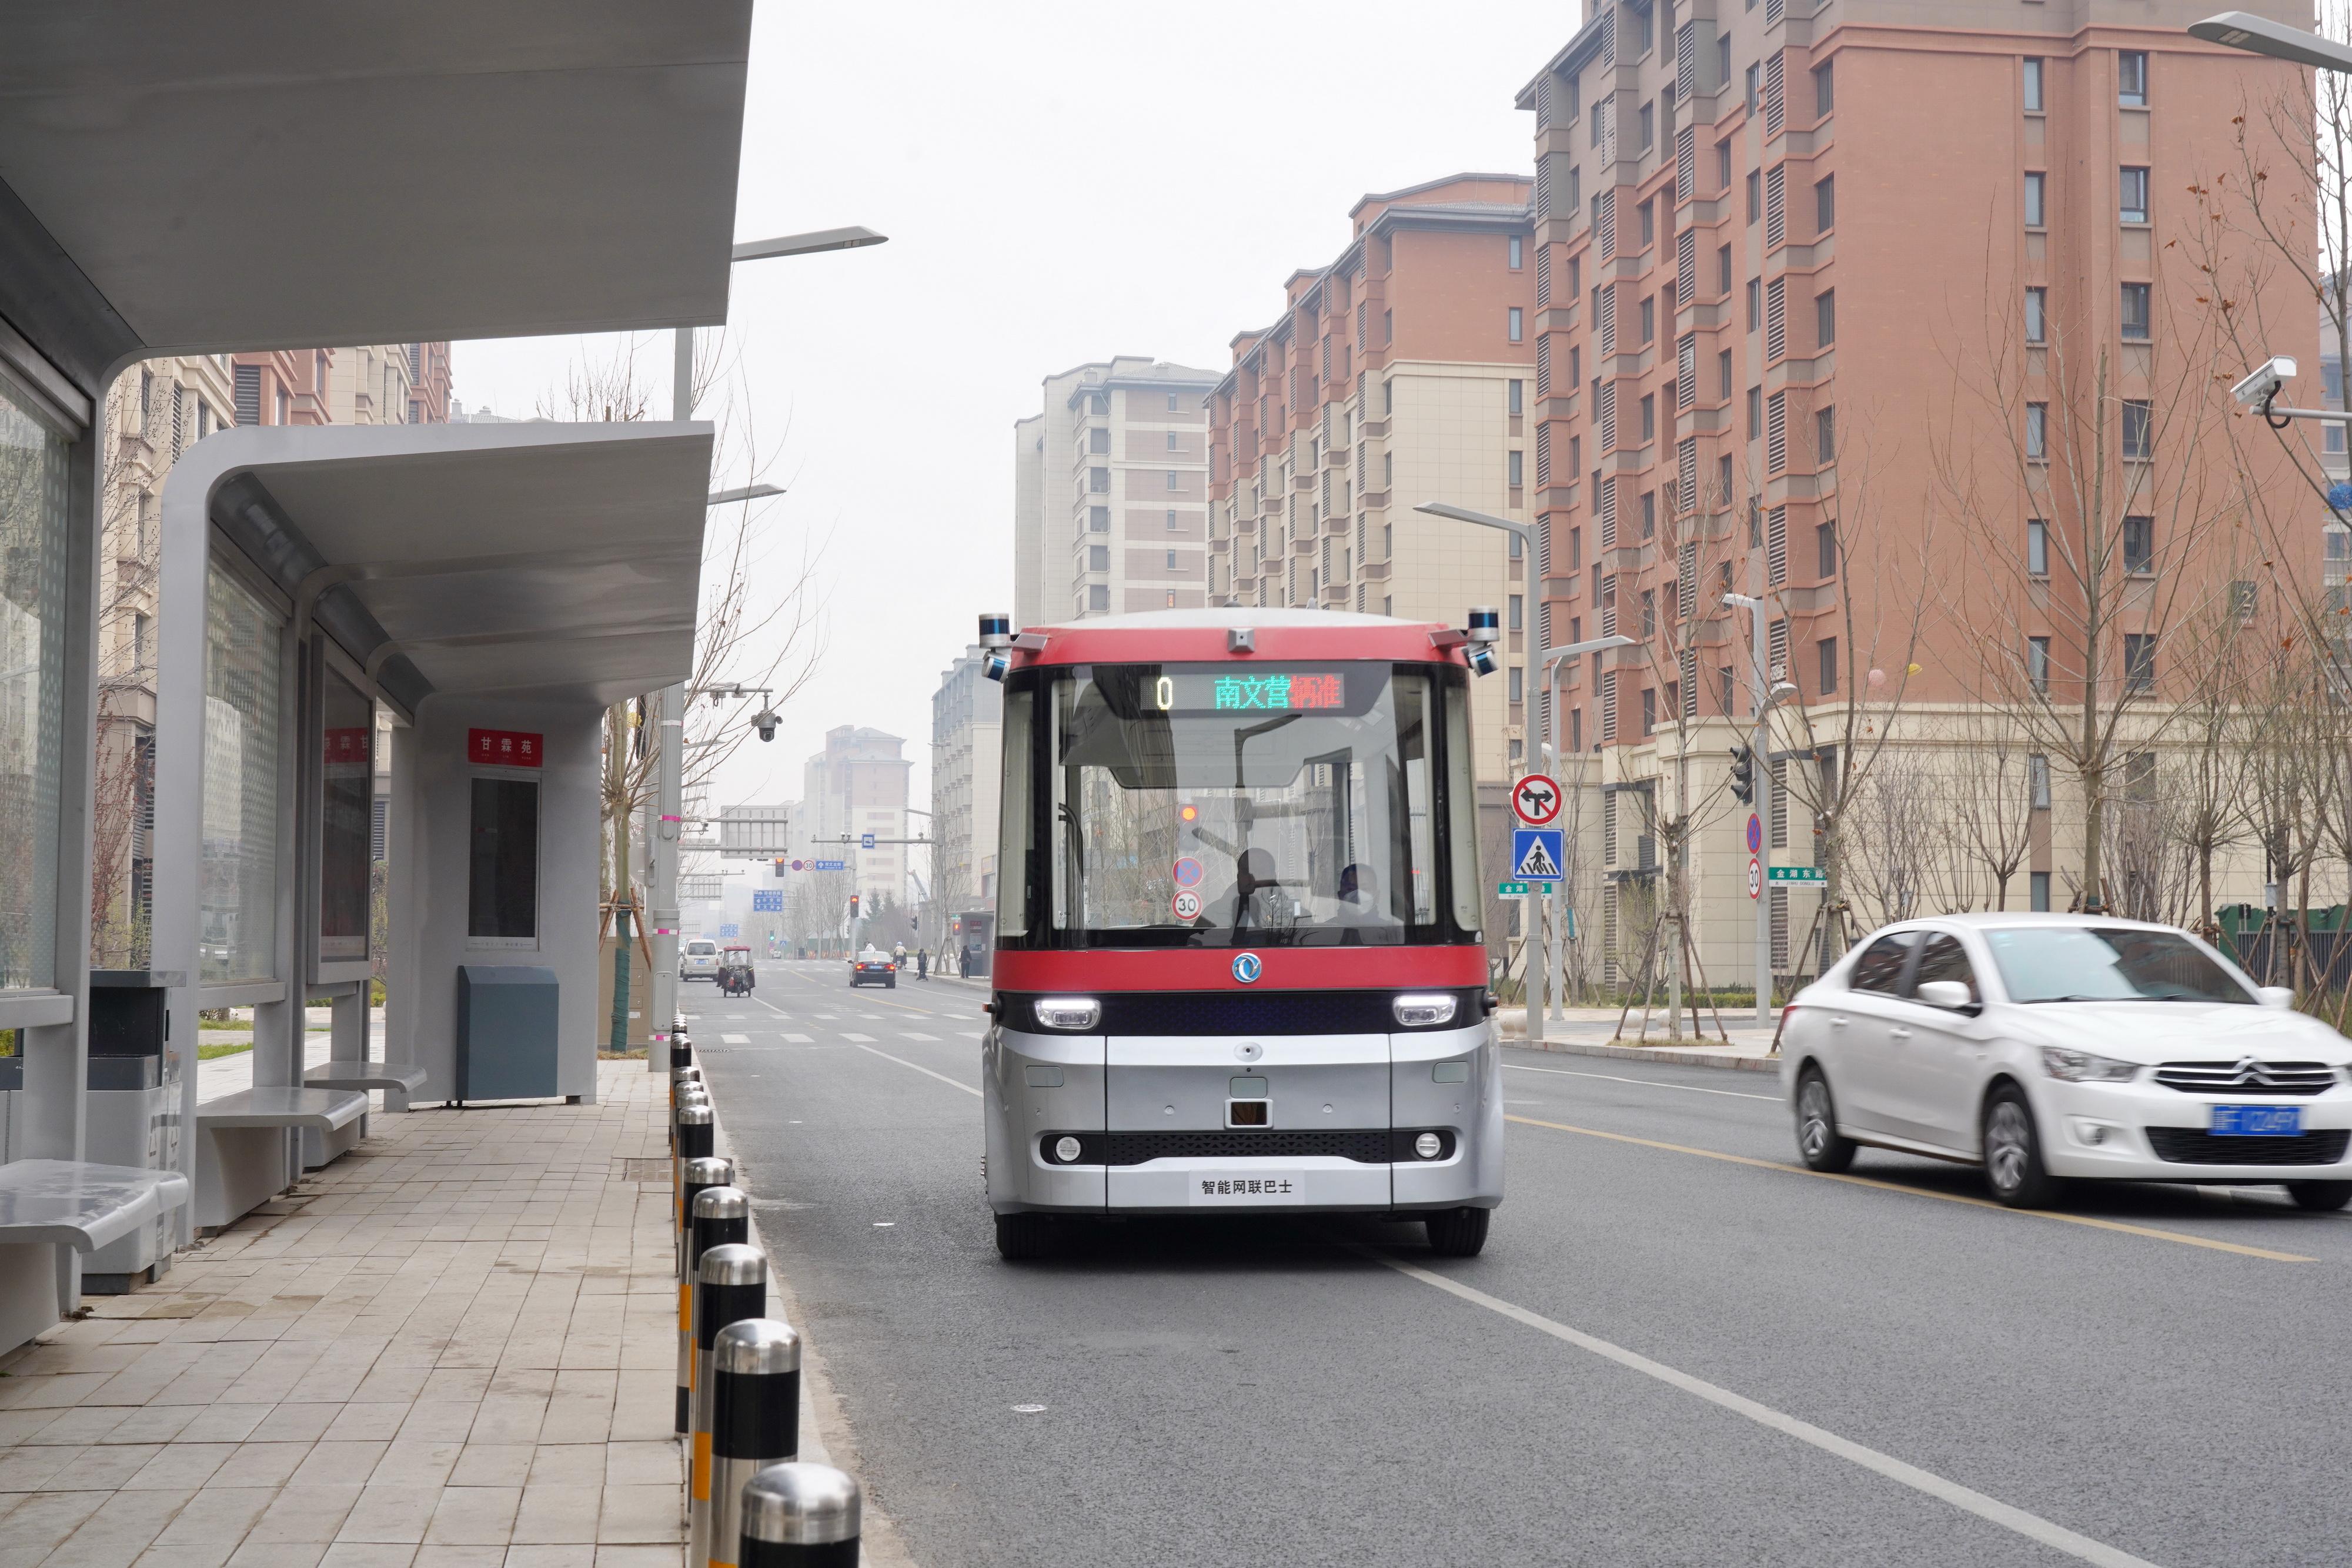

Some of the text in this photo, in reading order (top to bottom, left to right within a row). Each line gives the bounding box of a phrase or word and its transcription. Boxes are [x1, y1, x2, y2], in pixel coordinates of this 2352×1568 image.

[1157, 677, 1173, 710] 0
[1214, 676, 1291, 709] 南文营
[481, 737, 532, 754] 甘霖苑
[1750, 870, 1759, 888] 30
[1776, 869, 1823, 878] 金湖东路
[1178, 898, 1196, 912] 30
[1201, 1179, 1292, 1195] 智能网联巴士
